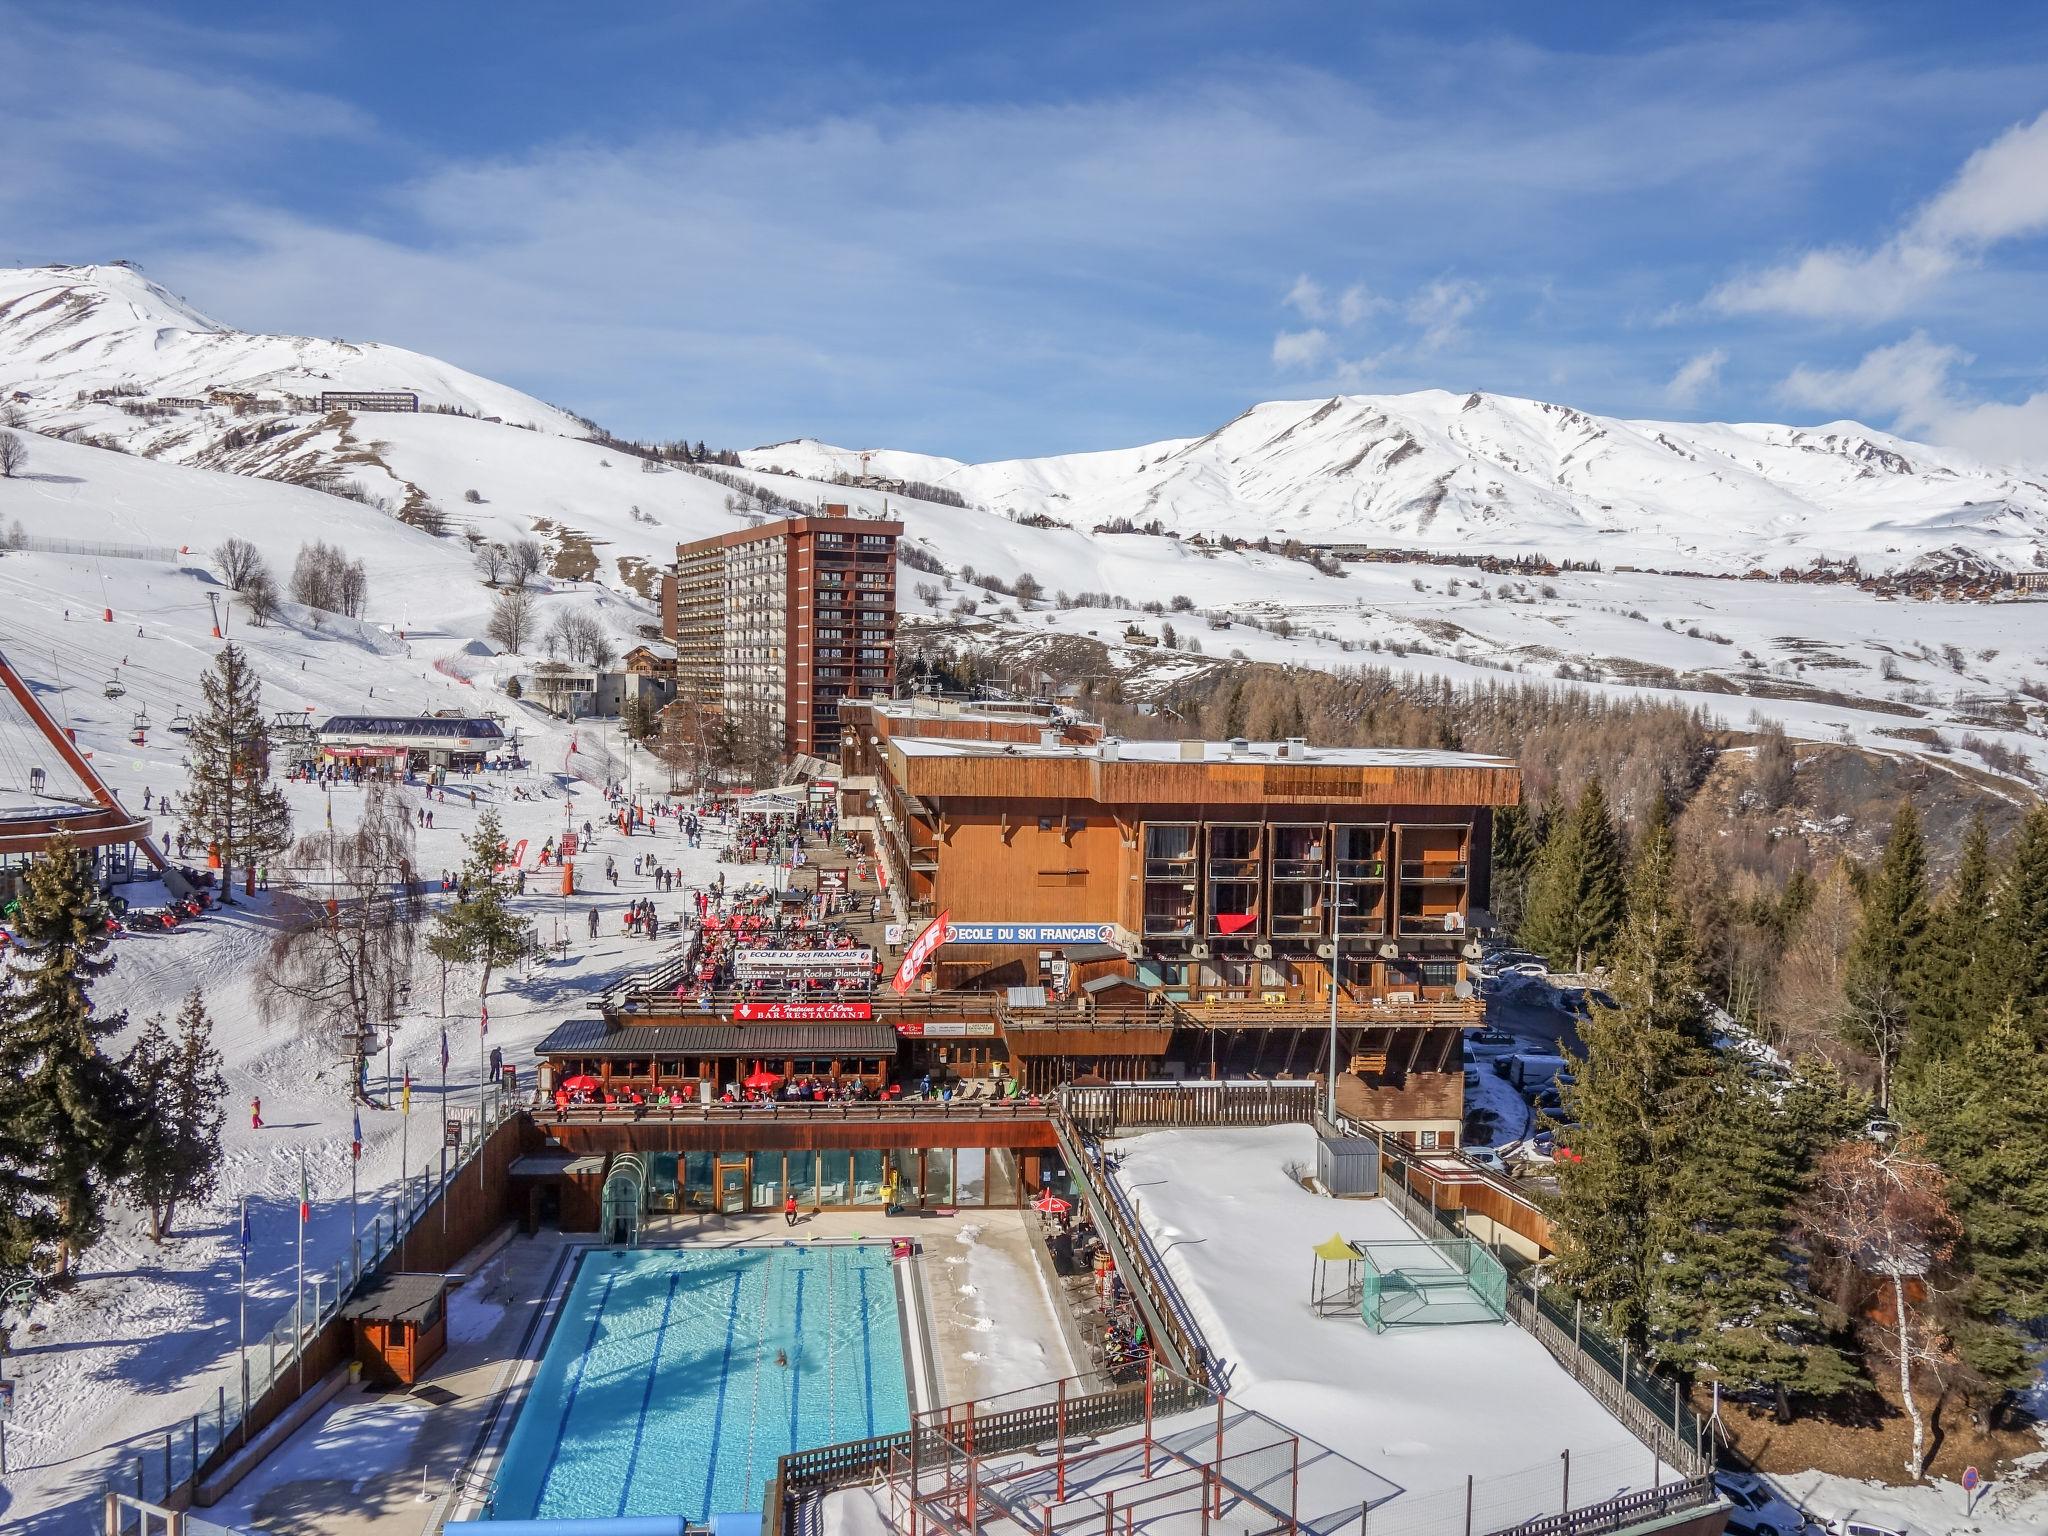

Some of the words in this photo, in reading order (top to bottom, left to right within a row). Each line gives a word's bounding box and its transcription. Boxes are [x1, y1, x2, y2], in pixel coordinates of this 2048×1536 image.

[958, 928, 993, 940] ECOLE
[998, 928, 1013, 940] DU
[1018, 928, 1036, 940] SKI
[1040, 928, 1096, 942] FRANÇAIS
[786, 968, 801, 978] Les
[803, 967, 833, 978] Roches
[834, 967, 871, 978] Blanches
[816, 1004, 825, 1012] de
[757, 1011, 865, 1019] BAR-RESTAURANT
